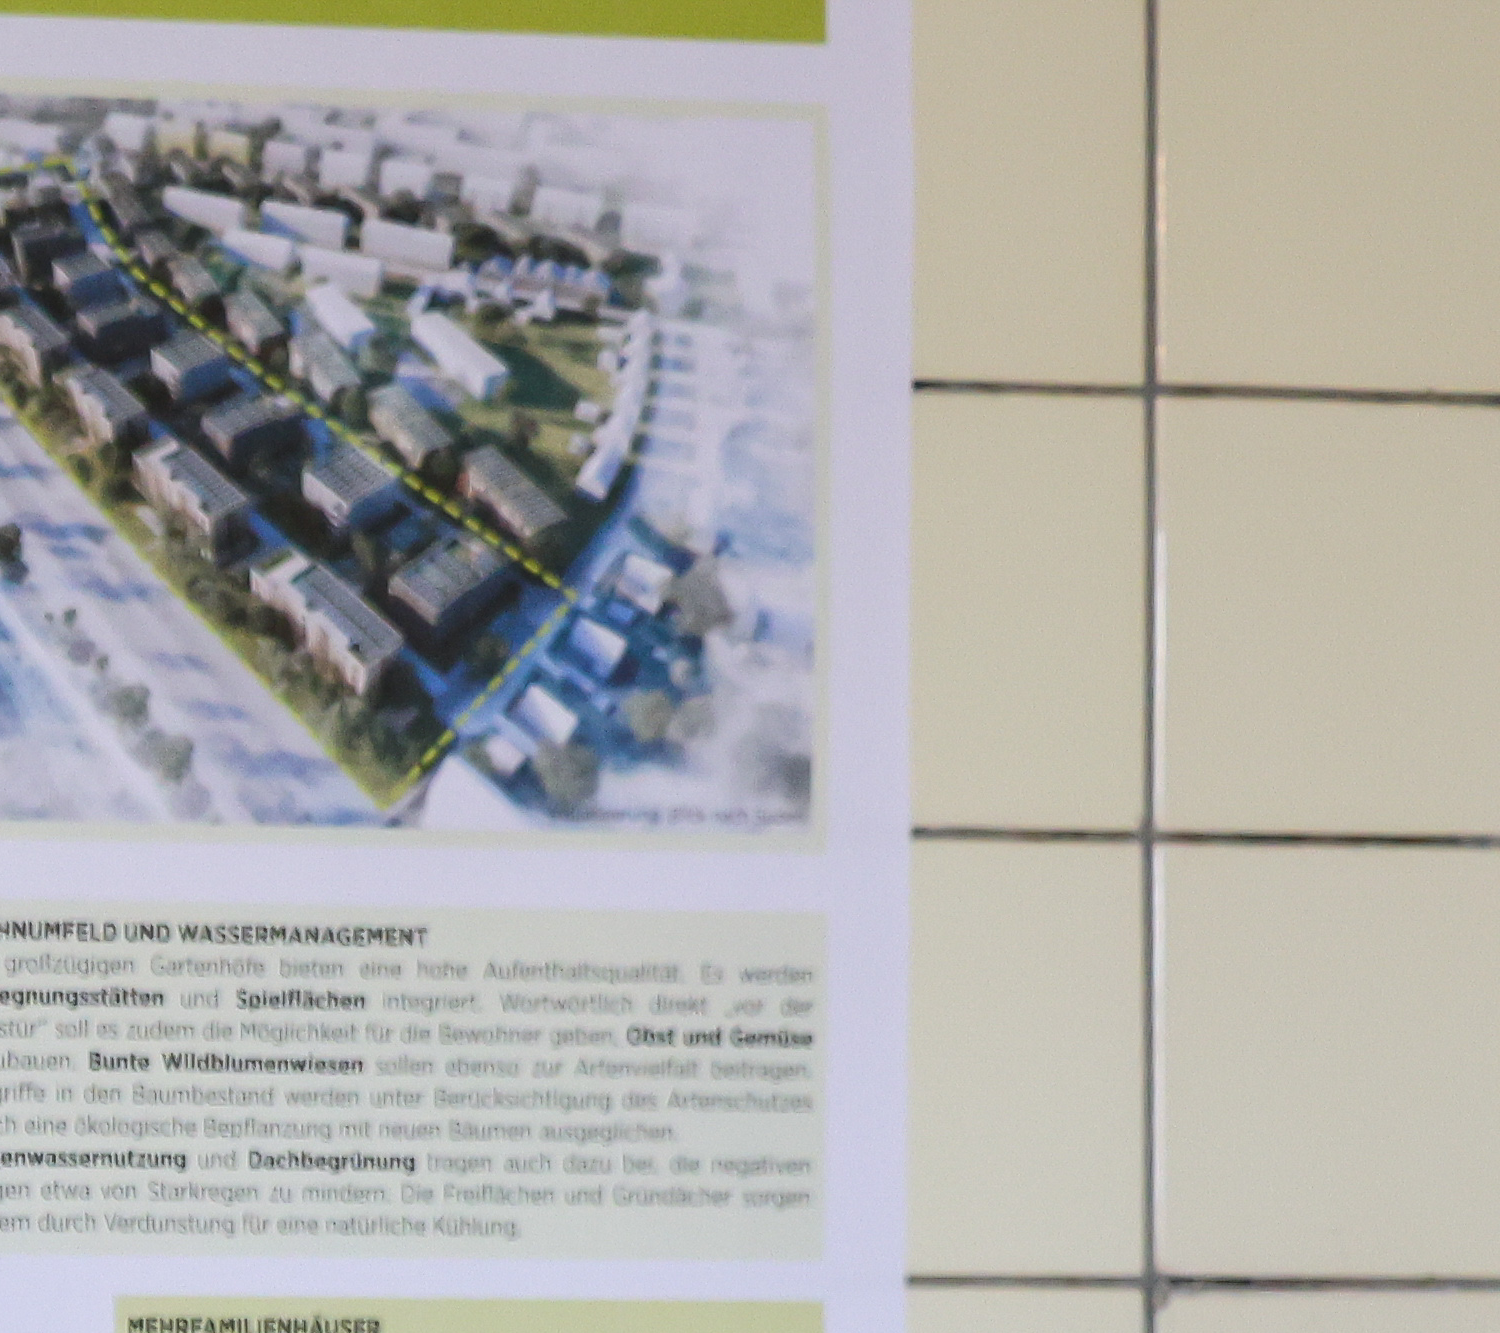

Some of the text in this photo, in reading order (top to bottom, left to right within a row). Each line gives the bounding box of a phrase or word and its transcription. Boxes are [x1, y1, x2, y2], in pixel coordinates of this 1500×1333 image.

[124, 923, 171, 943] UND
[178, 924, 428, 947] WASSERMANAGEMENT
[247, 1147, 420, 1178] Dachbegrünung
